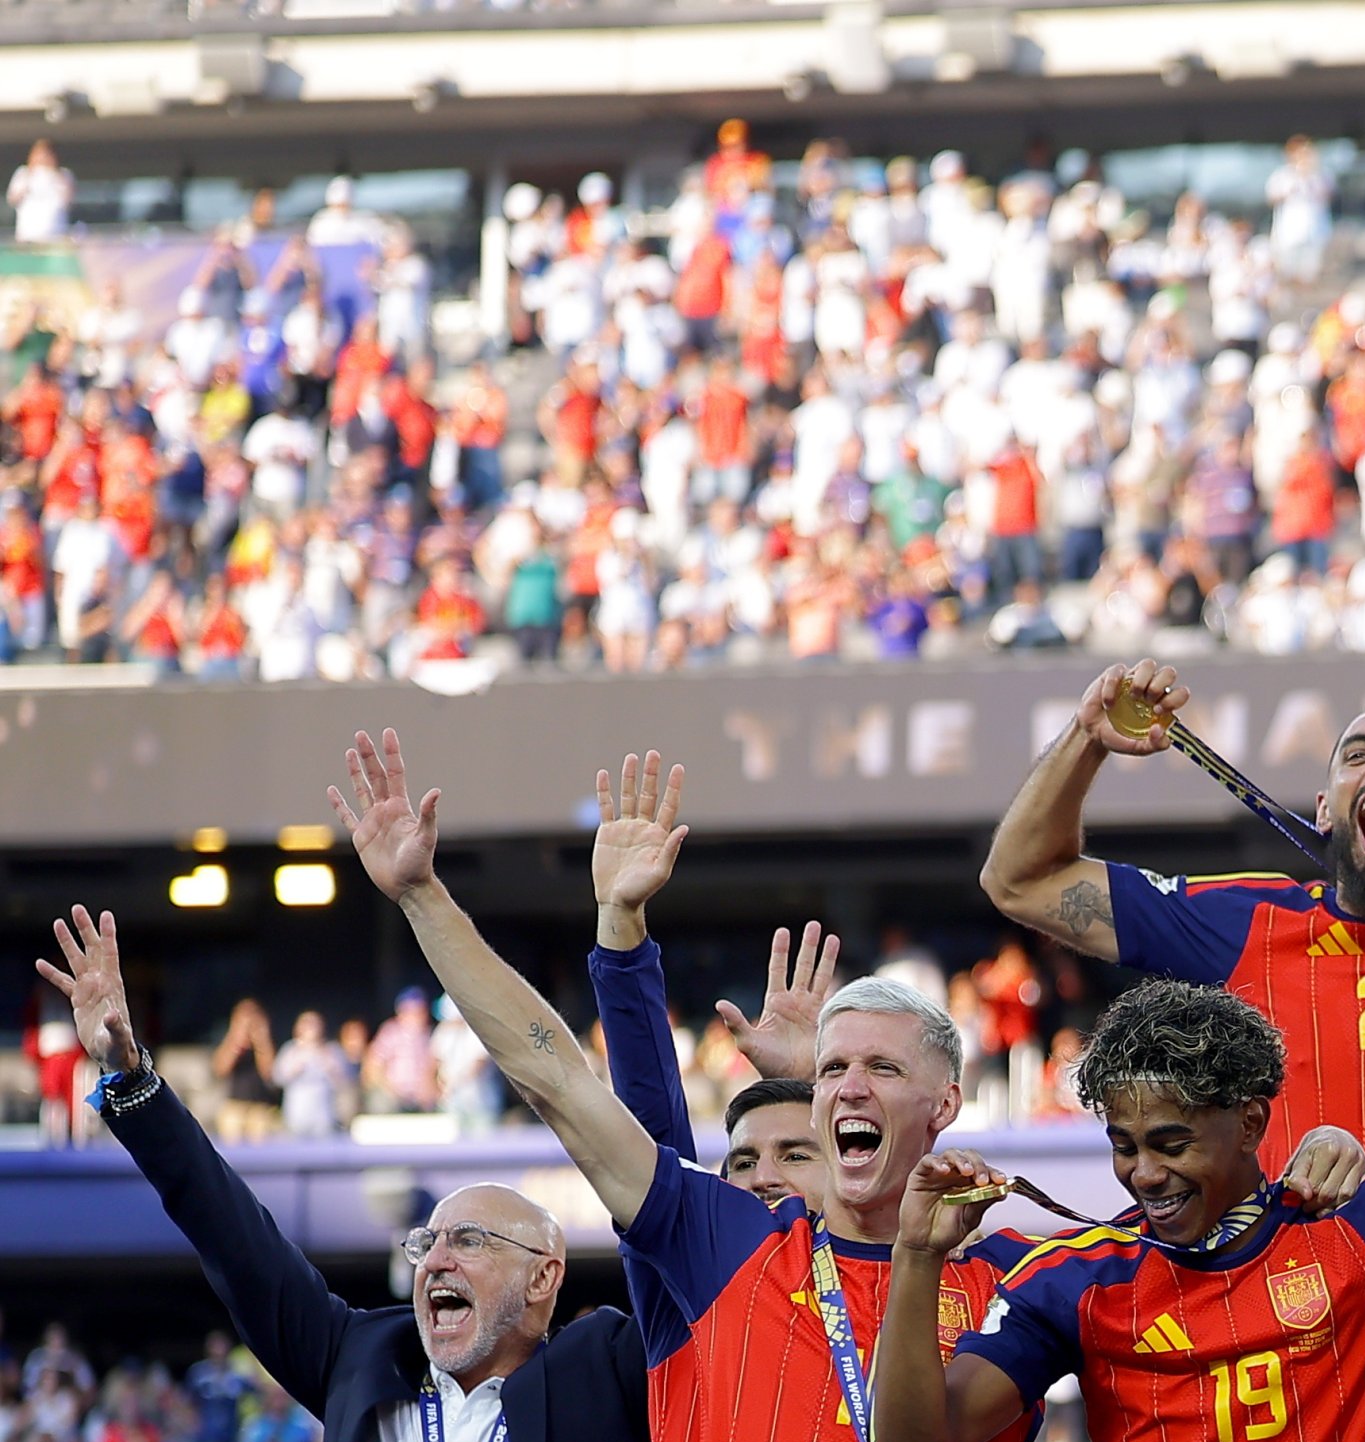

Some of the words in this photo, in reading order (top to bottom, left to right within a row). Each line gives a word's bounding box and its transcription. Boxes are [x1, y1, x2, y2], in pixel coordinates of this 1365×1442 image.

[426, 1402, 437, 1425] FIFA
[841, 1356, 855, 1382] FIFA
[848, 1382, 866, 1427] WORLD
